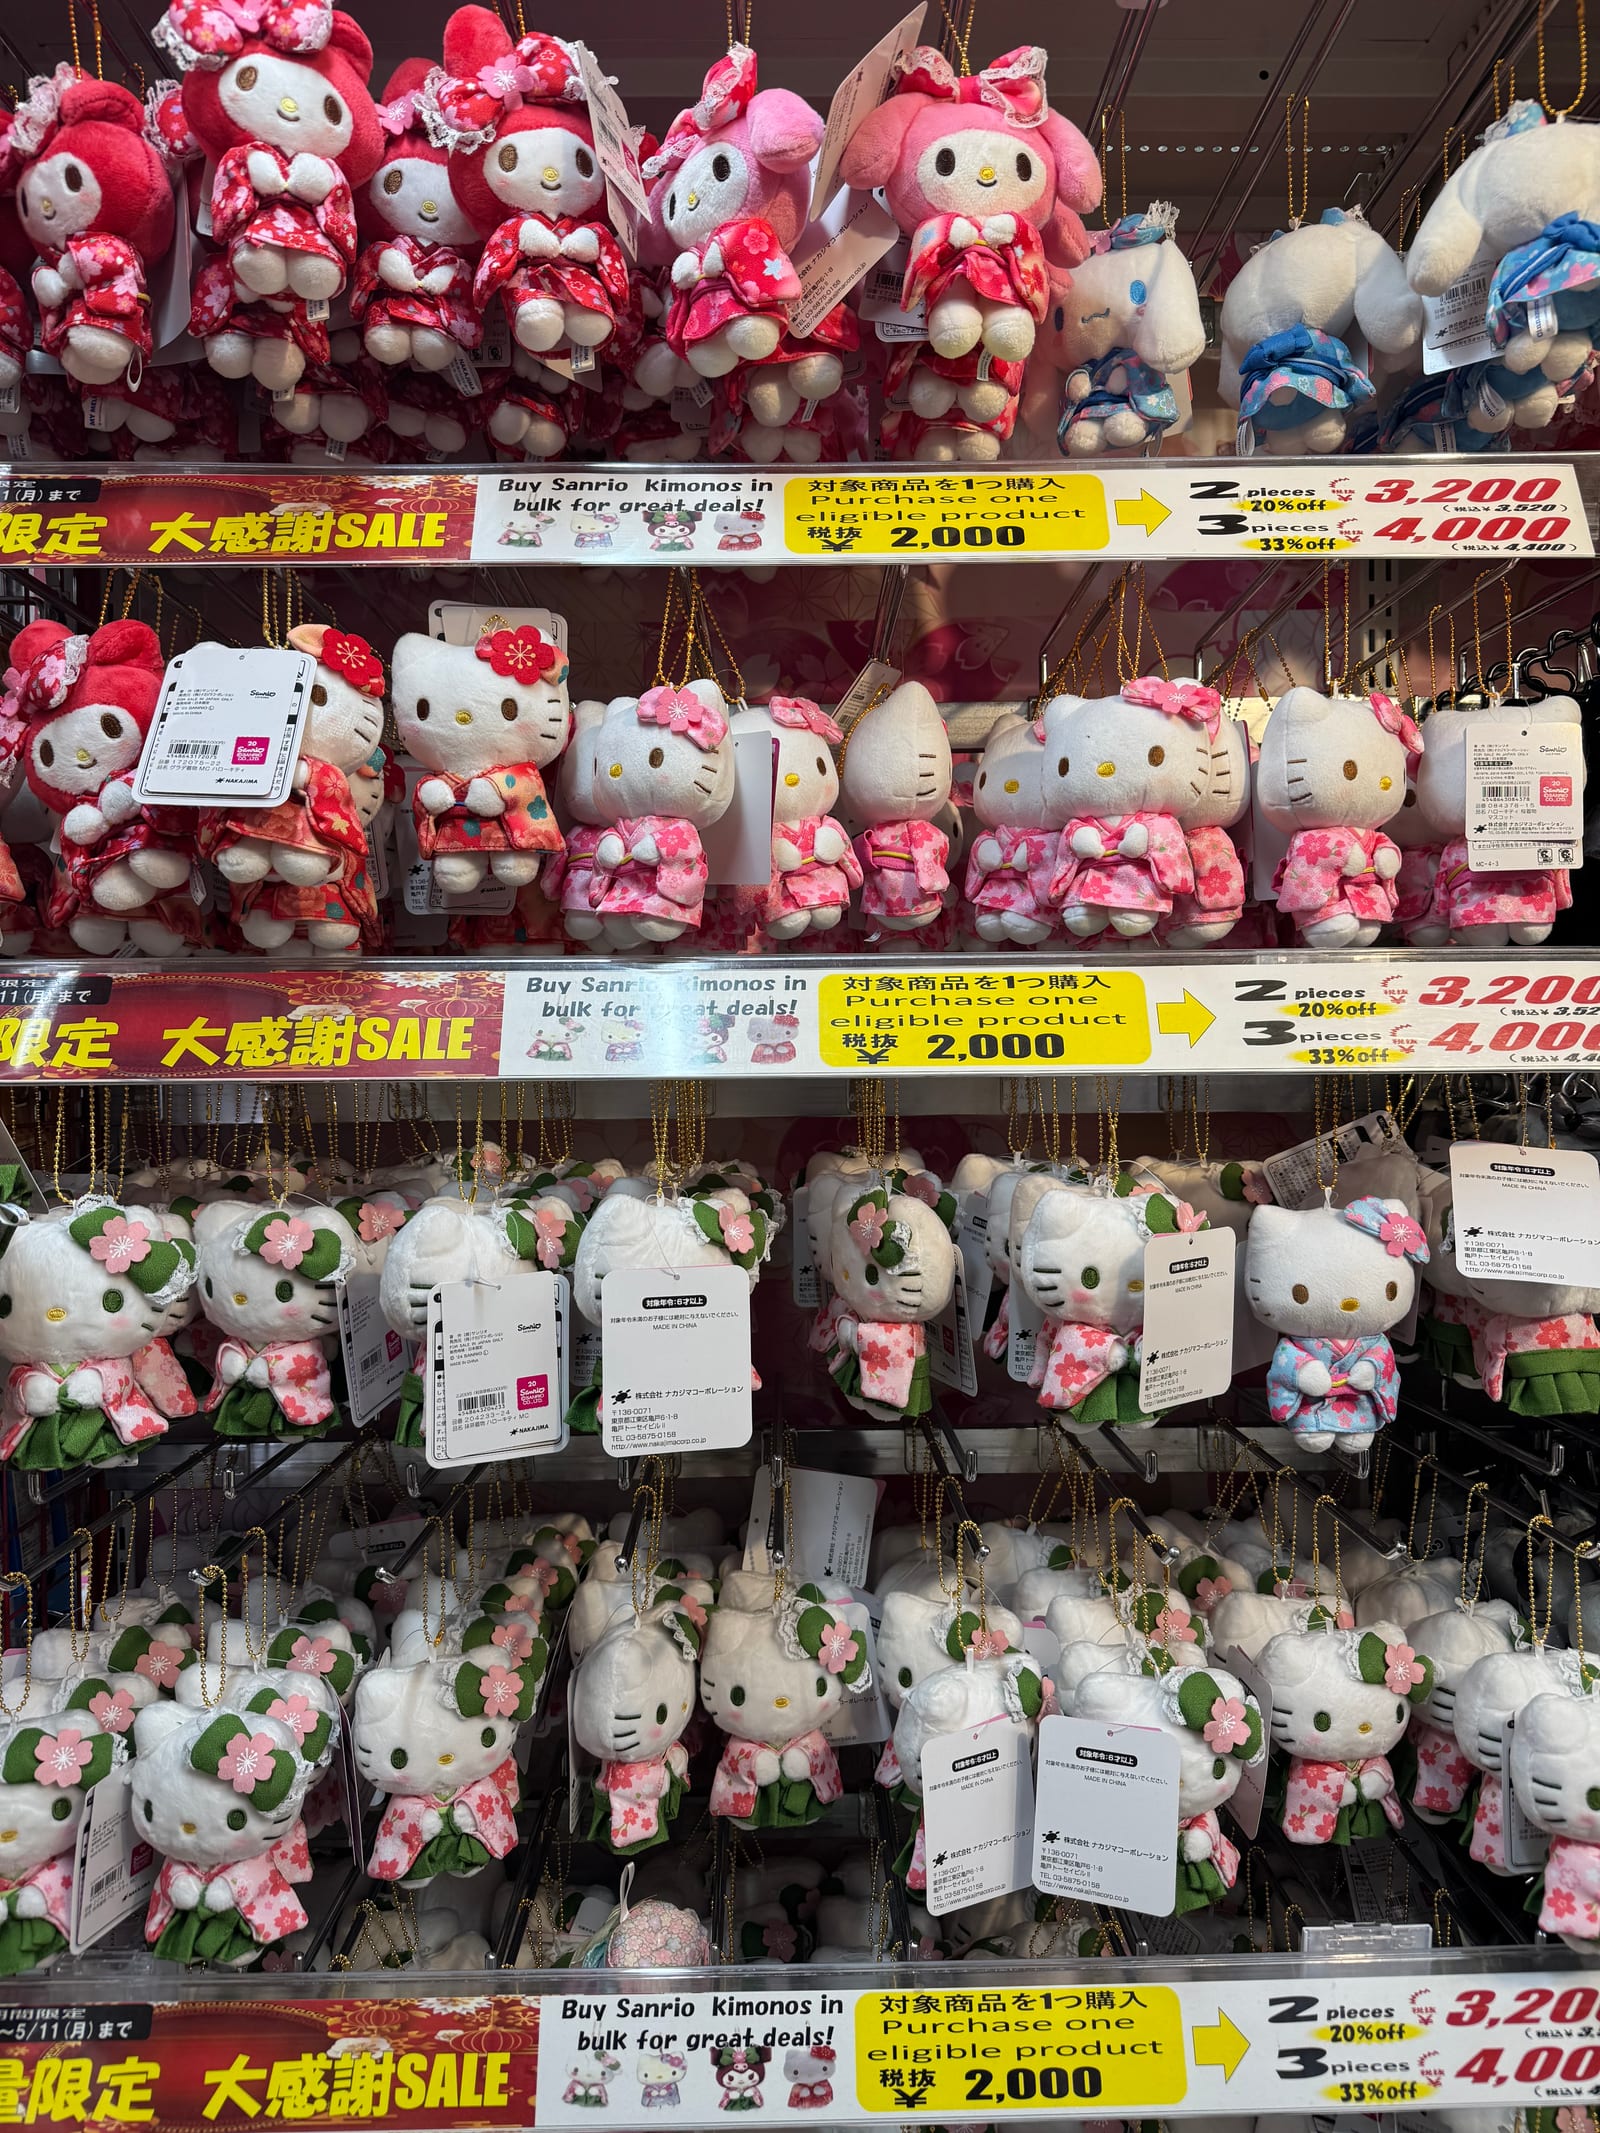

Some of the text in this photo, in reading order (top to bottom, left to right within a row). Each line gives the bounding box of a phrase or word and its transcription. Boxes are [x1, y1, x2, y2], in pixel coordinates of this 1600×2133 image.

[460, 358, 475, 391] NAKAJIMA
[499, 478, 542, 494] Buy
[551, 477, 629, 492] Sanrio
[751, 479, 773, 492] in
[808, 477, 1066, 493] 対象商品を1つ購入
[1189, 481, 1316, 499] 2 pieces
[1364, 478, 1562, 506] 3,200
[513, 498, 765, 514] bulk for great deals!
[811, 493, 1058, 505] Purchase one
[1250, 499, 1327, 512] 20%off
[796, 508, 1087, 524] eligible product
[1197, 514, 1329, 535] 3 pieces
[147, 511, 448, 555] 大感謝SALE
[807, 526, 863, 540] 税抜
[821, 526, 1026, 552] ¥ 2,000
[1372, 516, 1571, 544] 4,000
[1259, 537, 1337, 551] 33%off
[250, 689, 277, 697] Sanrio
[1539, 745, 1568, 753] Sanrio
[1543, 786, 1569, 794] Sanrio
[526, 977, 572, 995] Buy
[784, 975, 807, 991] in
[842, 974, 1112, 991] 対象商品を1つ購入
[1234, 979, 1366, 1002] 2 pieces
[542, 998, 798, 1018] bulk for deals!
[846, 994, 1098, 1008] Purchase one
[1298, 1001, 1377, 1018] 20%off
[830, 1012, 1127, 1030] eligible product
[160, 1016, 475, 1068] 大感謝SALE
[842, 1033, 899, 1049] 税抜
[1242, 1020, 1382, 1046] 3 pieces
[853, 1033, 1065, 1065] ¥ 2,000
[1308, 1048, 1390, 1065] 33%off
[1487, 1230, 1600, 1246] 株式会社 ナカジマコーポレーション
[645, 1296, 705, 1308] 対象年令:6才以上
[517, 1322, 542, 1332] Sanrio
[1180, 1338, 1228, 1355] ナカジマコーポレーション
[520, 1386, 546, 1396] Sanrio
[635, 1385, 744, 1400] 株式会社 ナカジマコーポレーション
[611, 1407, 652, 1417] 〒136-0071
[519, 1423, 550, 1433] NAKAJIMA
[611, 1431, 677, 1443] TEL 03-5875-0158
[611, 1437, 707, 1450] http://www.nakajimacorp.co.jp
[1084, 1774, 1101, 1784] MADE
[1108, 1778, 1127, 1788] CHINA
[950, 1828, 1031, 1860] 株式会社 ナカジマコーポレーション
[1063, 1836, 1169, 1862] 株式会社 ナカジマコーポレーション
[1039, 1871, 1101, 1890] TEL 03-5875-0158
[561, 1998, 607, 2021] Buy
[616, 1997, 695, 2018] Sanrio
[820, 1994, 844, 2015] in
[879, 1989, 1148, 2015] 対象商品を1つ購入
[1268, 1995, 1396, 2024] 2 pieces
[1445, 1987, 1600, 2030] 3,20
[883, 2016, 1135, 2035] Purchase one
[1329, 2023, 1406, 2043] 20%off
[577, 2025, 835, 2052] bulk for great deals!
[867, 2039, 1164, 2063] eligible product
[1275, 2046, 1411, 2080] 3 pieces
[201, 2051, 511, 2122] 大感謝SALE
[879, 2067, 937, 2088] 税抜
[891, 2065, 1103, 2109] ¥ 2,000
[1339, 2081, 1418, 2103] 33%off
